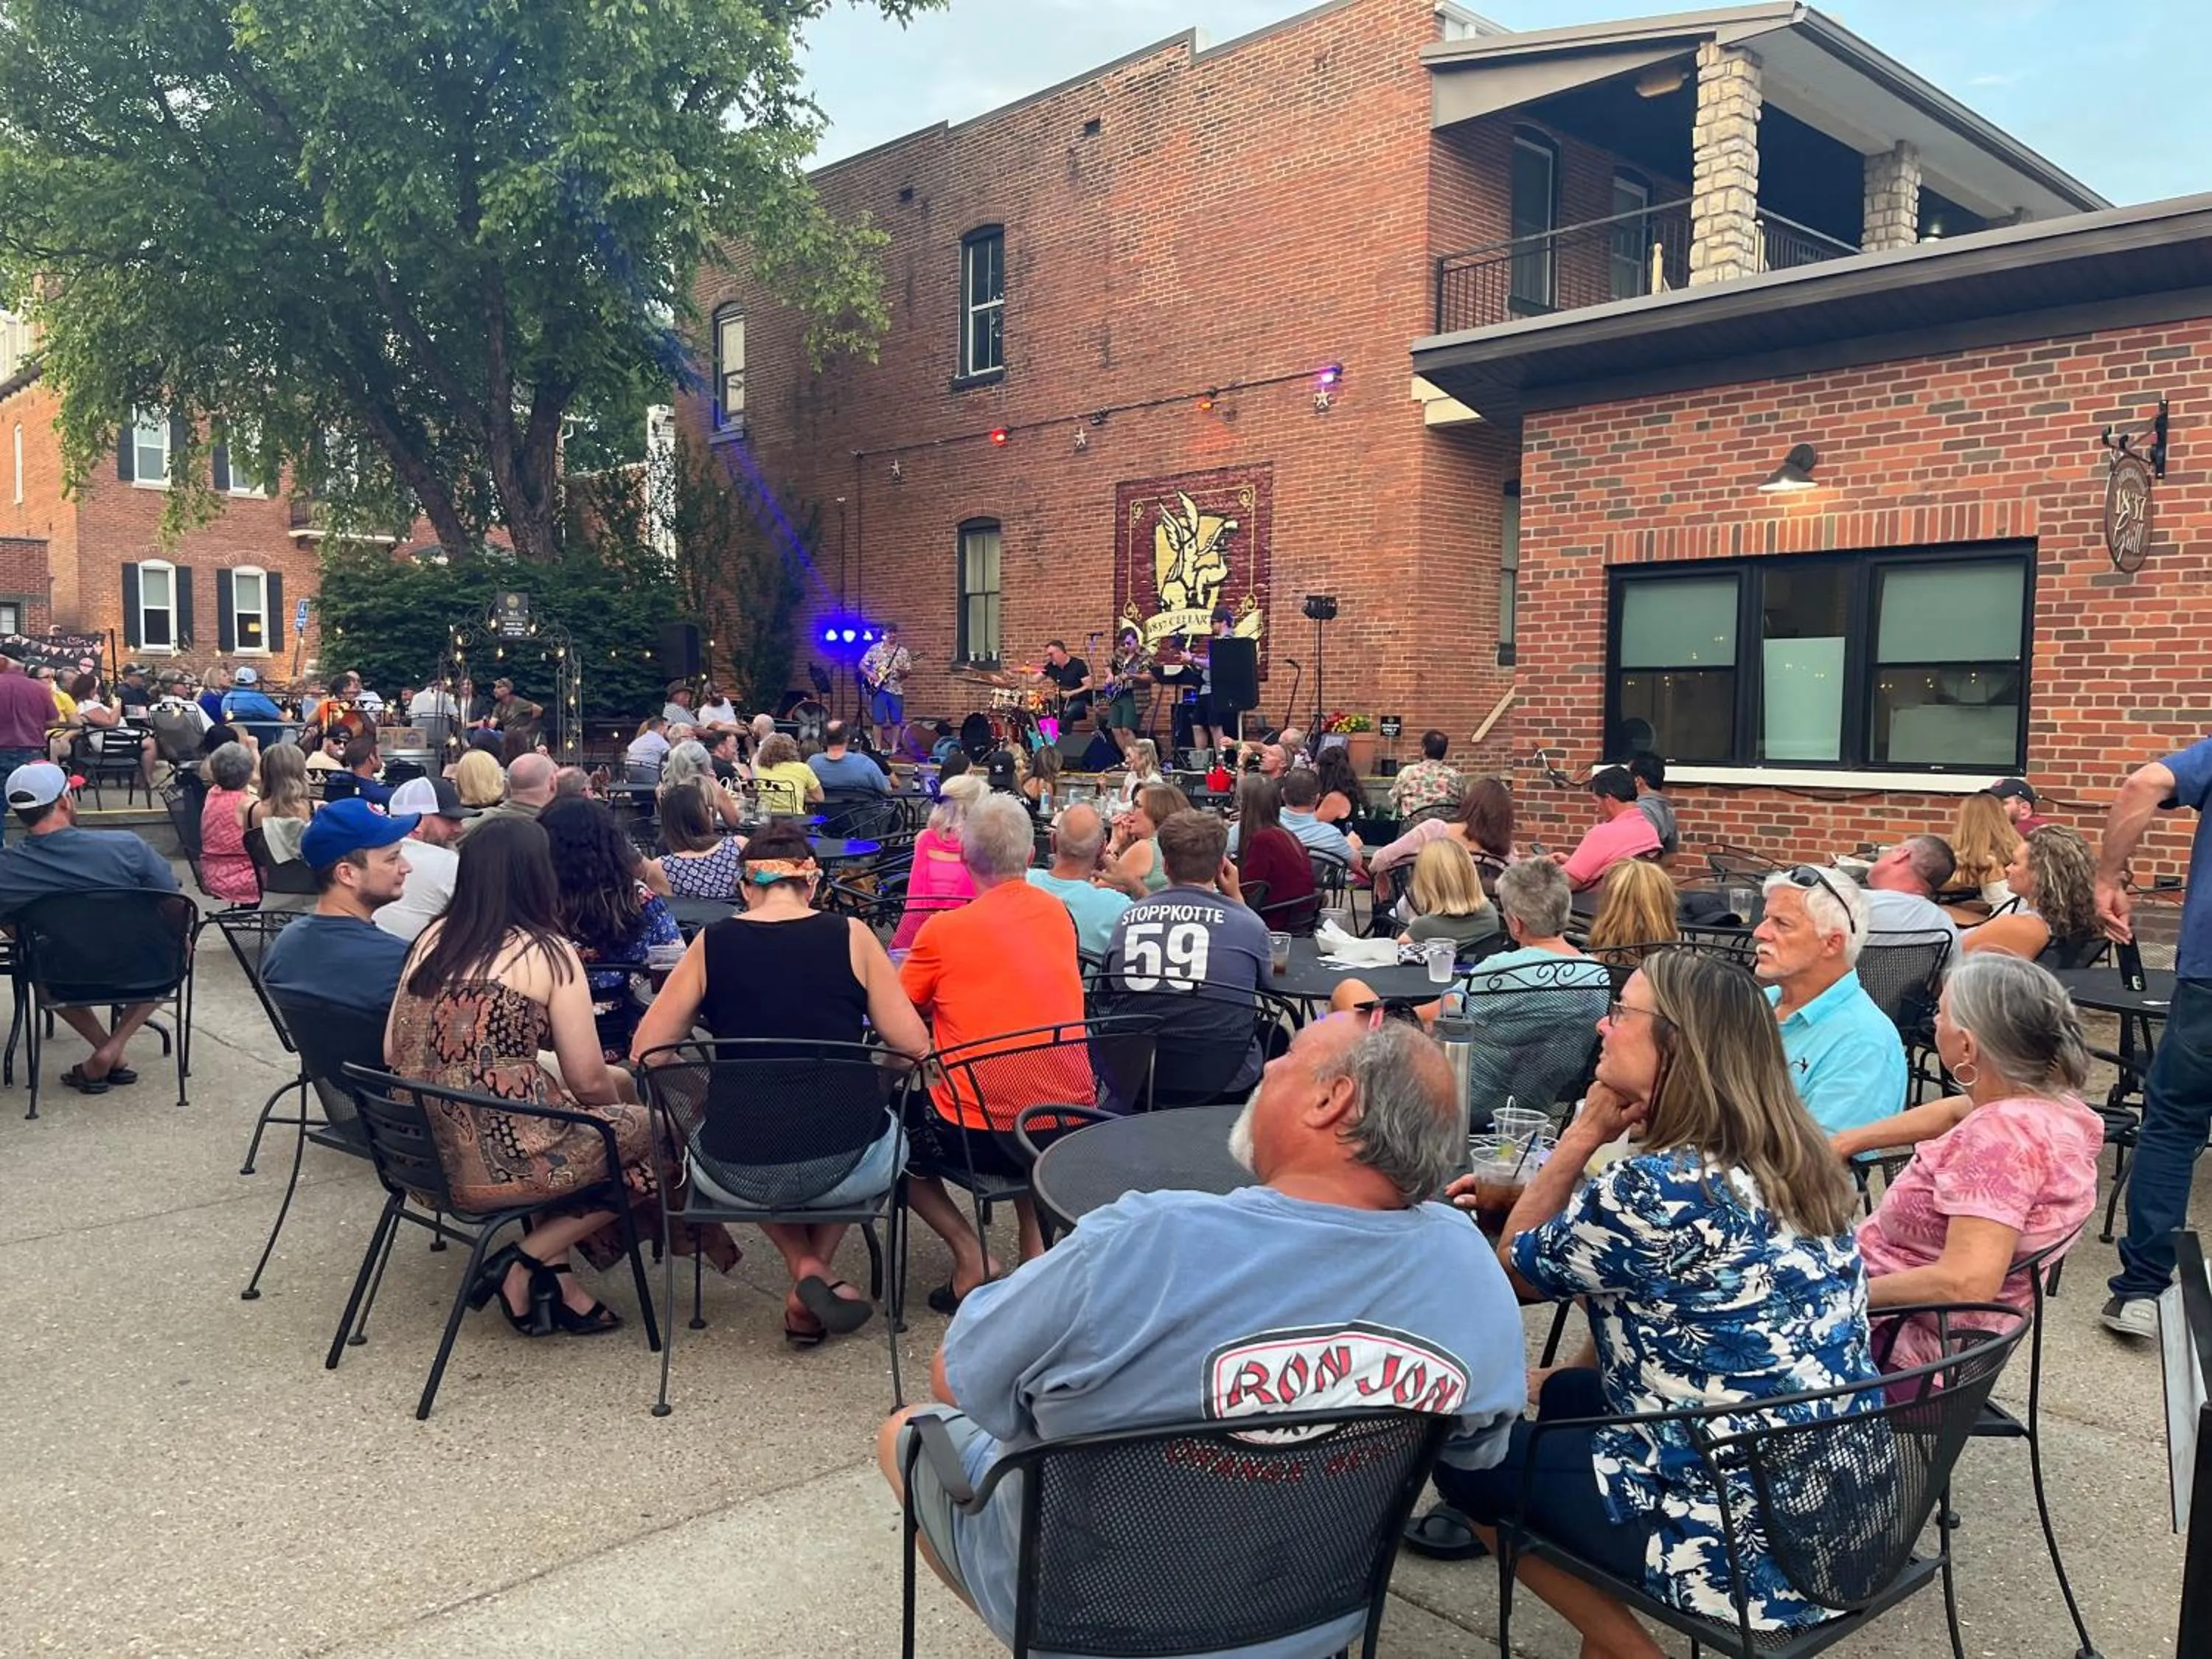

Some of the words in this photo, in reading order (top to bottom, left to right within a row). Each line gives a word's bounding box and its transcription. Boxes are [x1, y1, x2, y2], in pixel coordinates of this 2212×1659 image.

[2116, 487, 2146, 521] 1837
[2112, 509, 2143, 563] Grill
[1121, 905, 1225, 925] STOPPKOTTE
[1123, 922, 1210, 992] 59
[1227, 1346, 1353, 1410] RON
[1355, 1353, 1460, 1414] JON
